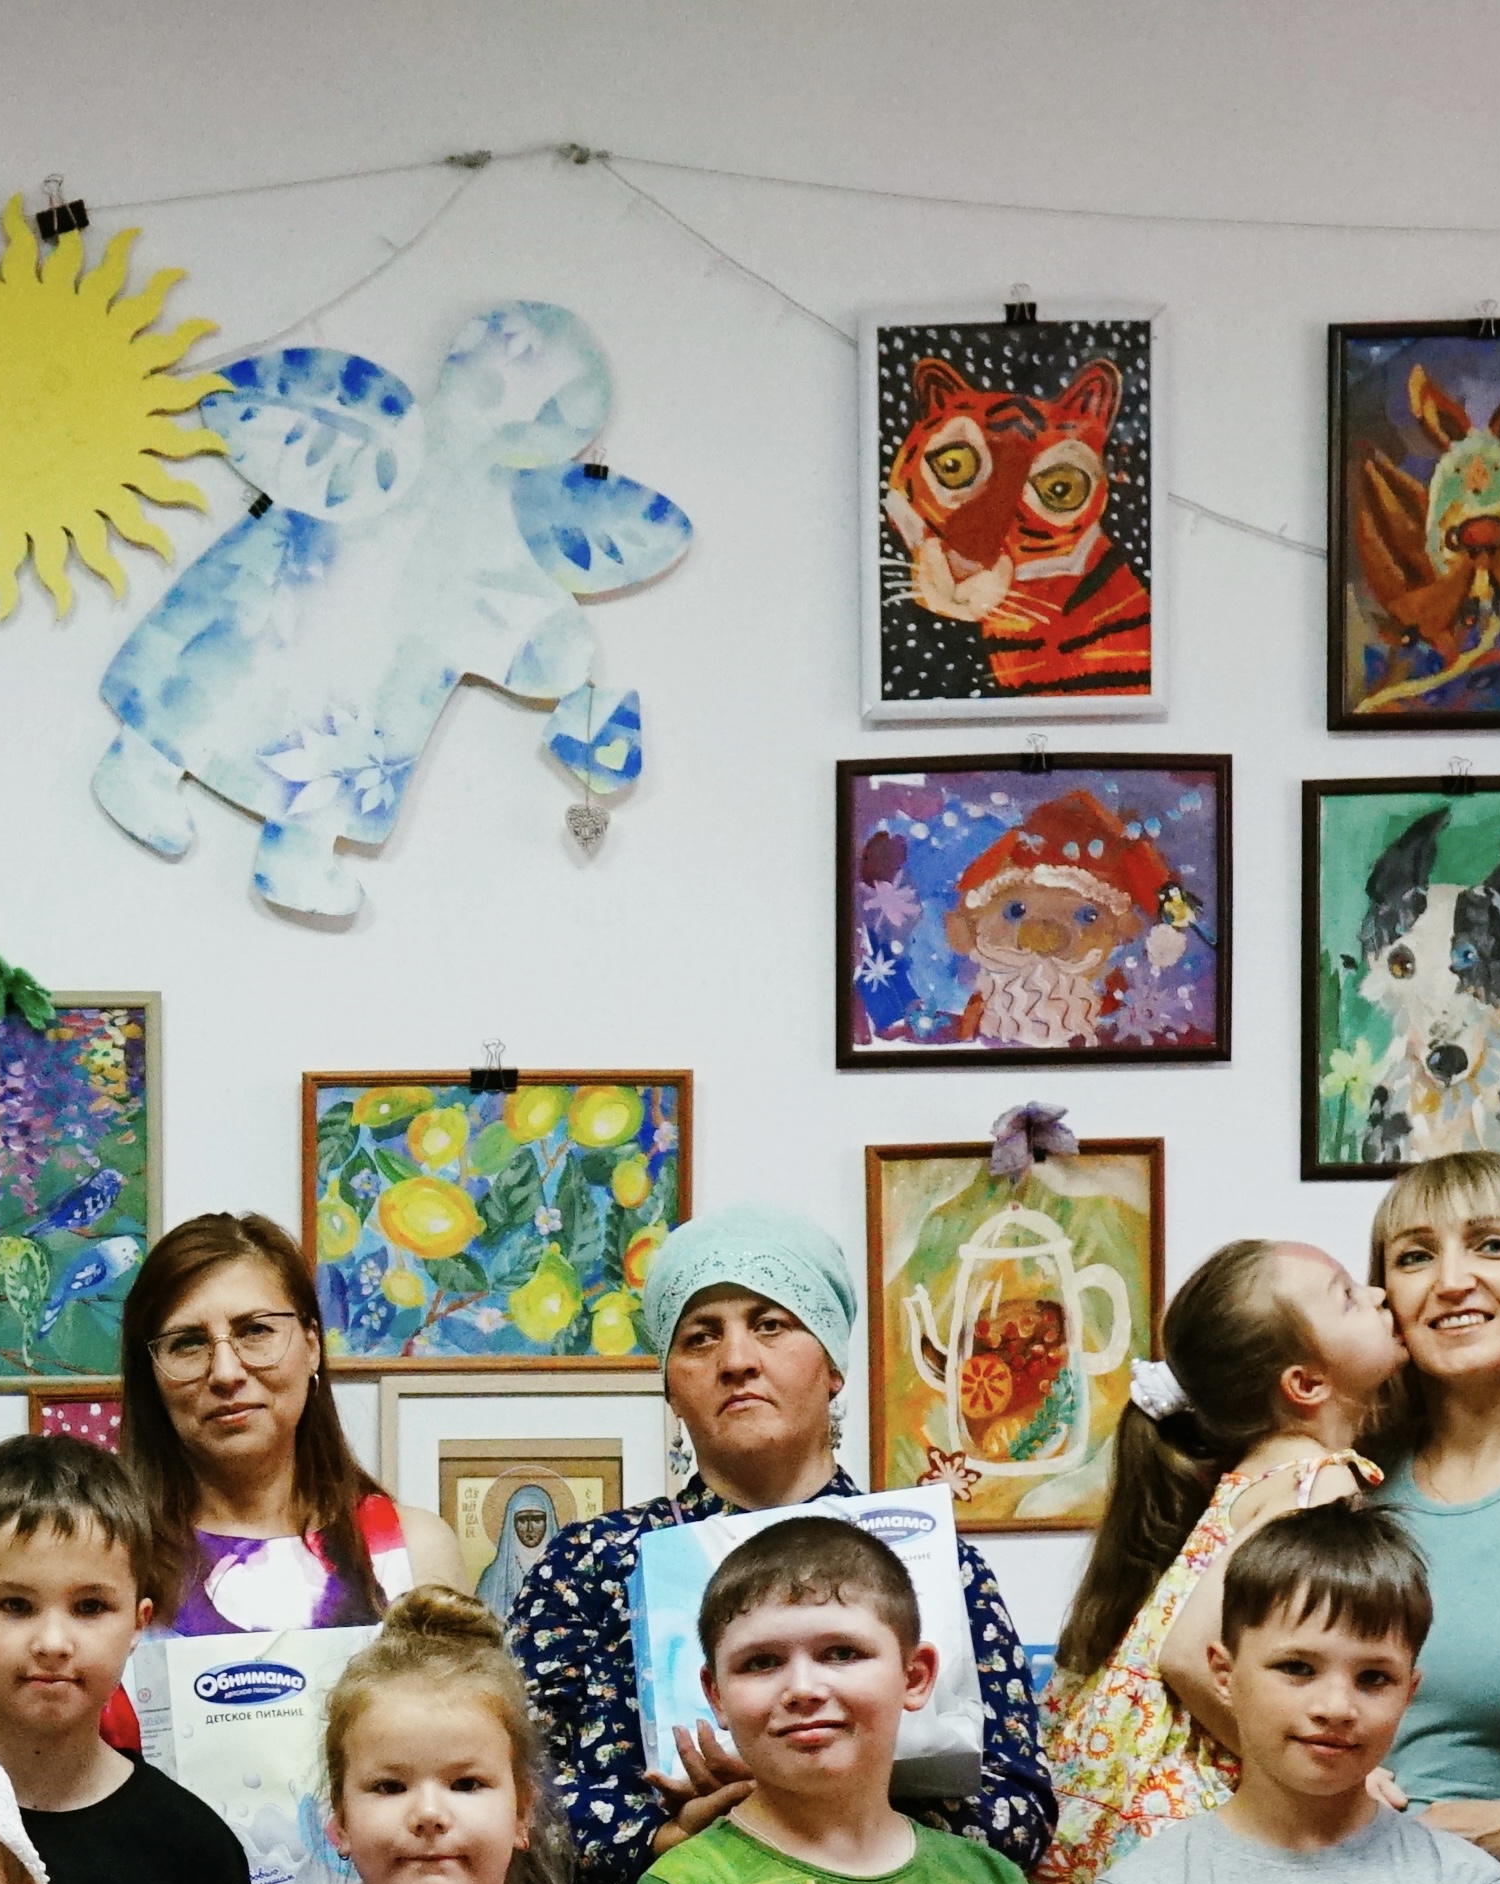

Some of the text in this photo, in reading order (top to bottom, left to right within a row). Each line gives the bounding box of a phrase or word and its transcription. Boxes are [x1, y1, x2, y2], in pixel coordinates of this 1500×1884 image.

[197, 1672, 303, 1697] Обнимама
[206, 1707, 304, 1725] ДЕТСКОЕ ПИТАНИЕ
